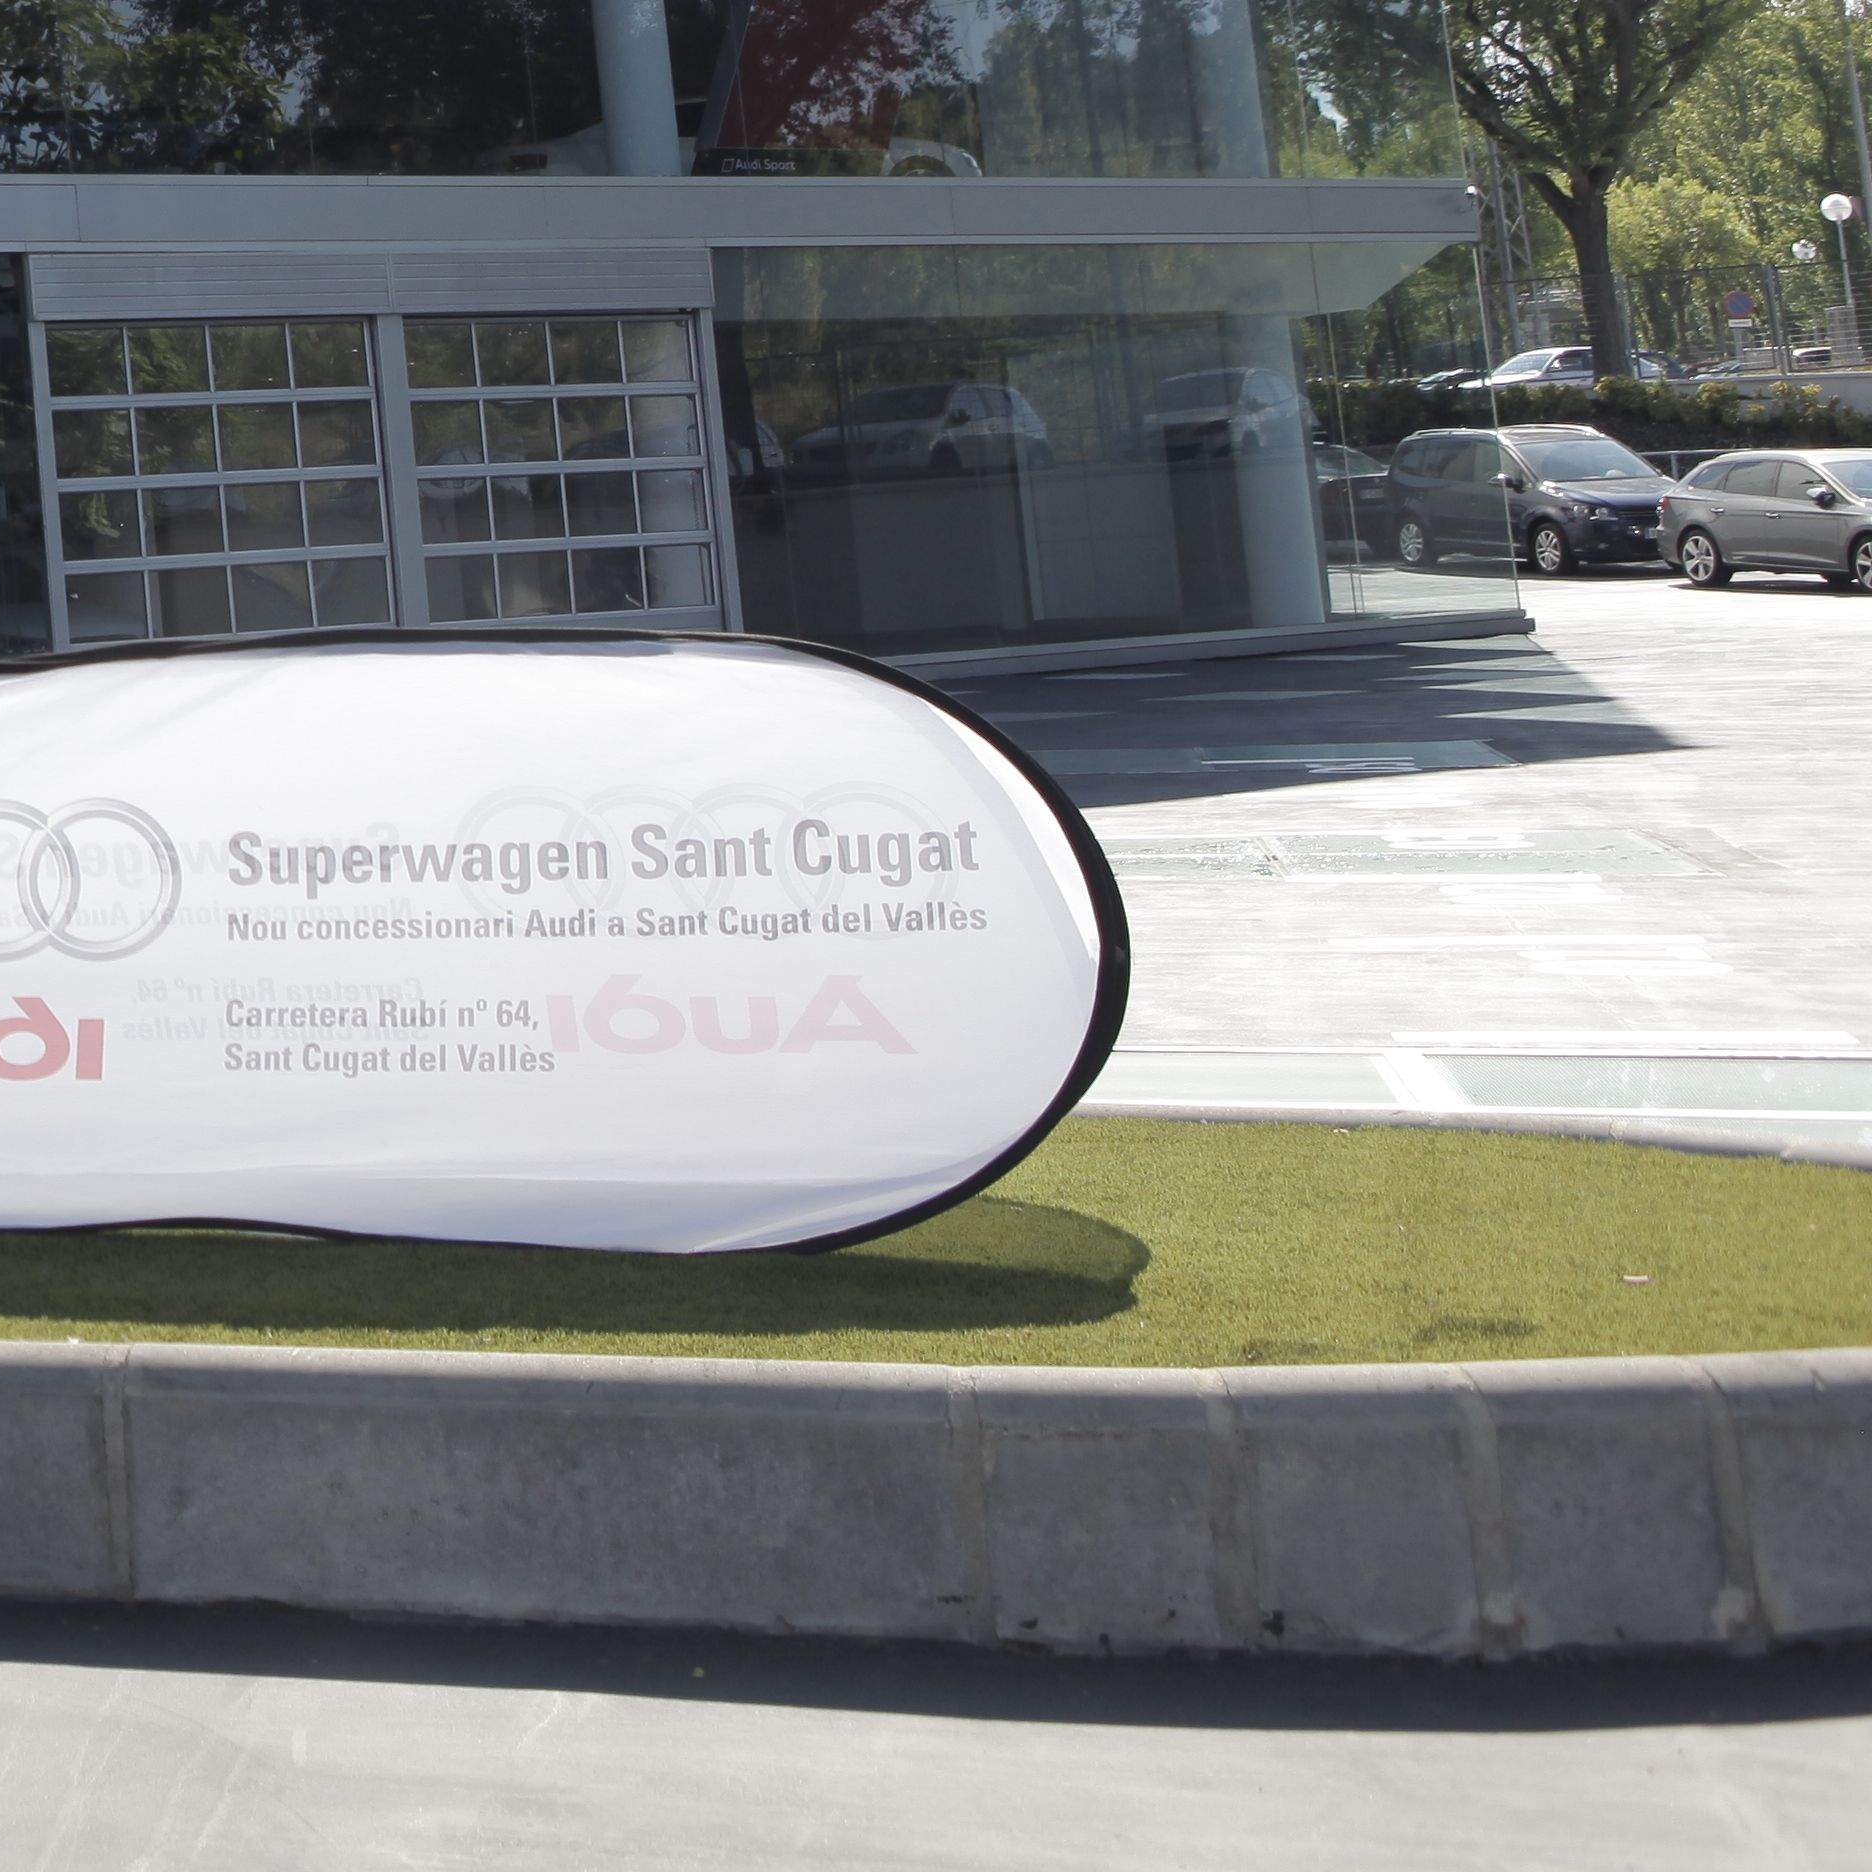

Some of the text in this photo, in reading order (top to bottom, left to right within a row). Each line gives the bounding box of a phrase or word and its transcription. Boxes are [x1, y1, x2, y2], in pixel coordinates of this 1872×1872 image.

[735, 158, 761, 170] Audi
[227, 818, 980, 899] Superwagen Sant Cugat
[227, 900, 988, 941] Nou concessionari Audi a Sant Cugat del Vallès
[225, 998, 368, 1028] Carretera
[379, 998, 447, 1028] Rubí
[496, 999, 539, 1030] 64,
[224, 1043, 556, 1078] Sant Cugat del Vallès
